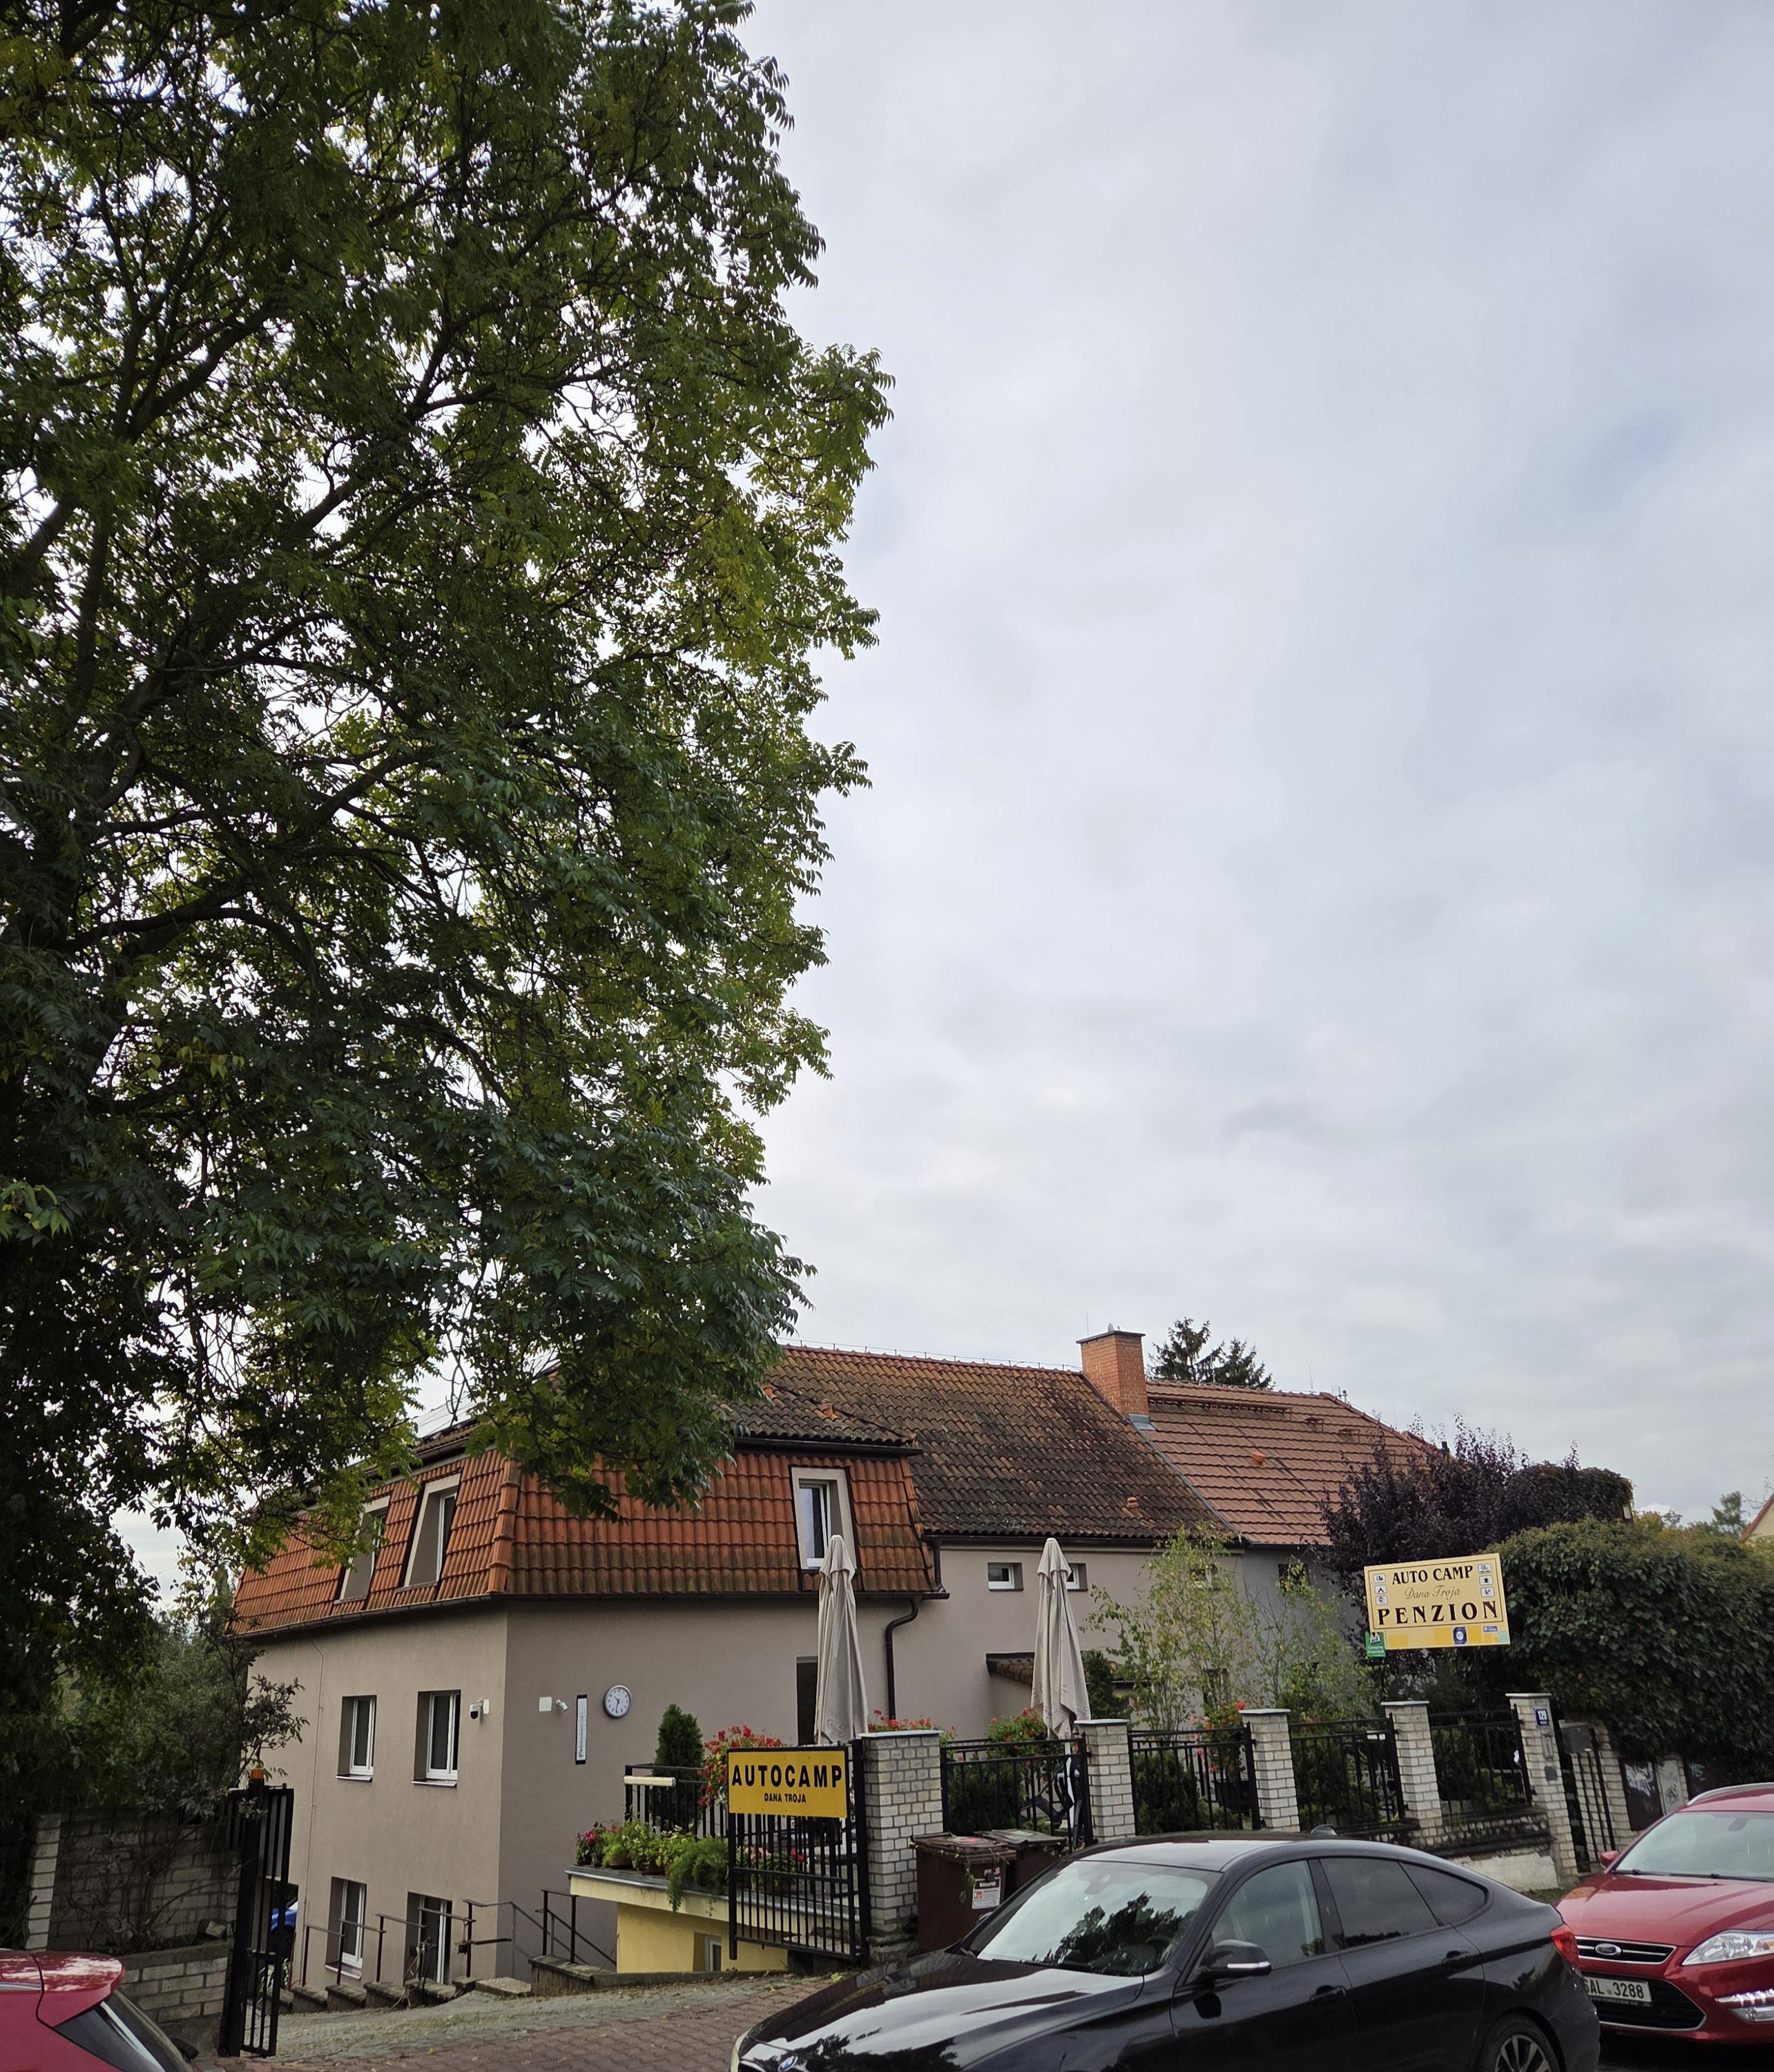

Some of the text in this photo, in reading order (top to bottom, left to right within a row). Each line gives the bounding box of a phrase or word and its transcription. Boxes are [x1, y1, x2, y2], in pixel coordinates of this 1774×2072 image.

[1392, 1565, 1473, 1585] AUTO CAMP
[1404, 1584, 1462, 1601] Dana Troja
[1378, 1600, 1497, 1625] PENZION
[731, 1765, 842, 1787] AUTOCAMP
[764, 1792, 807, 1803] DANA TROJA
[1612, 1982, 1643, 1999] 3288
